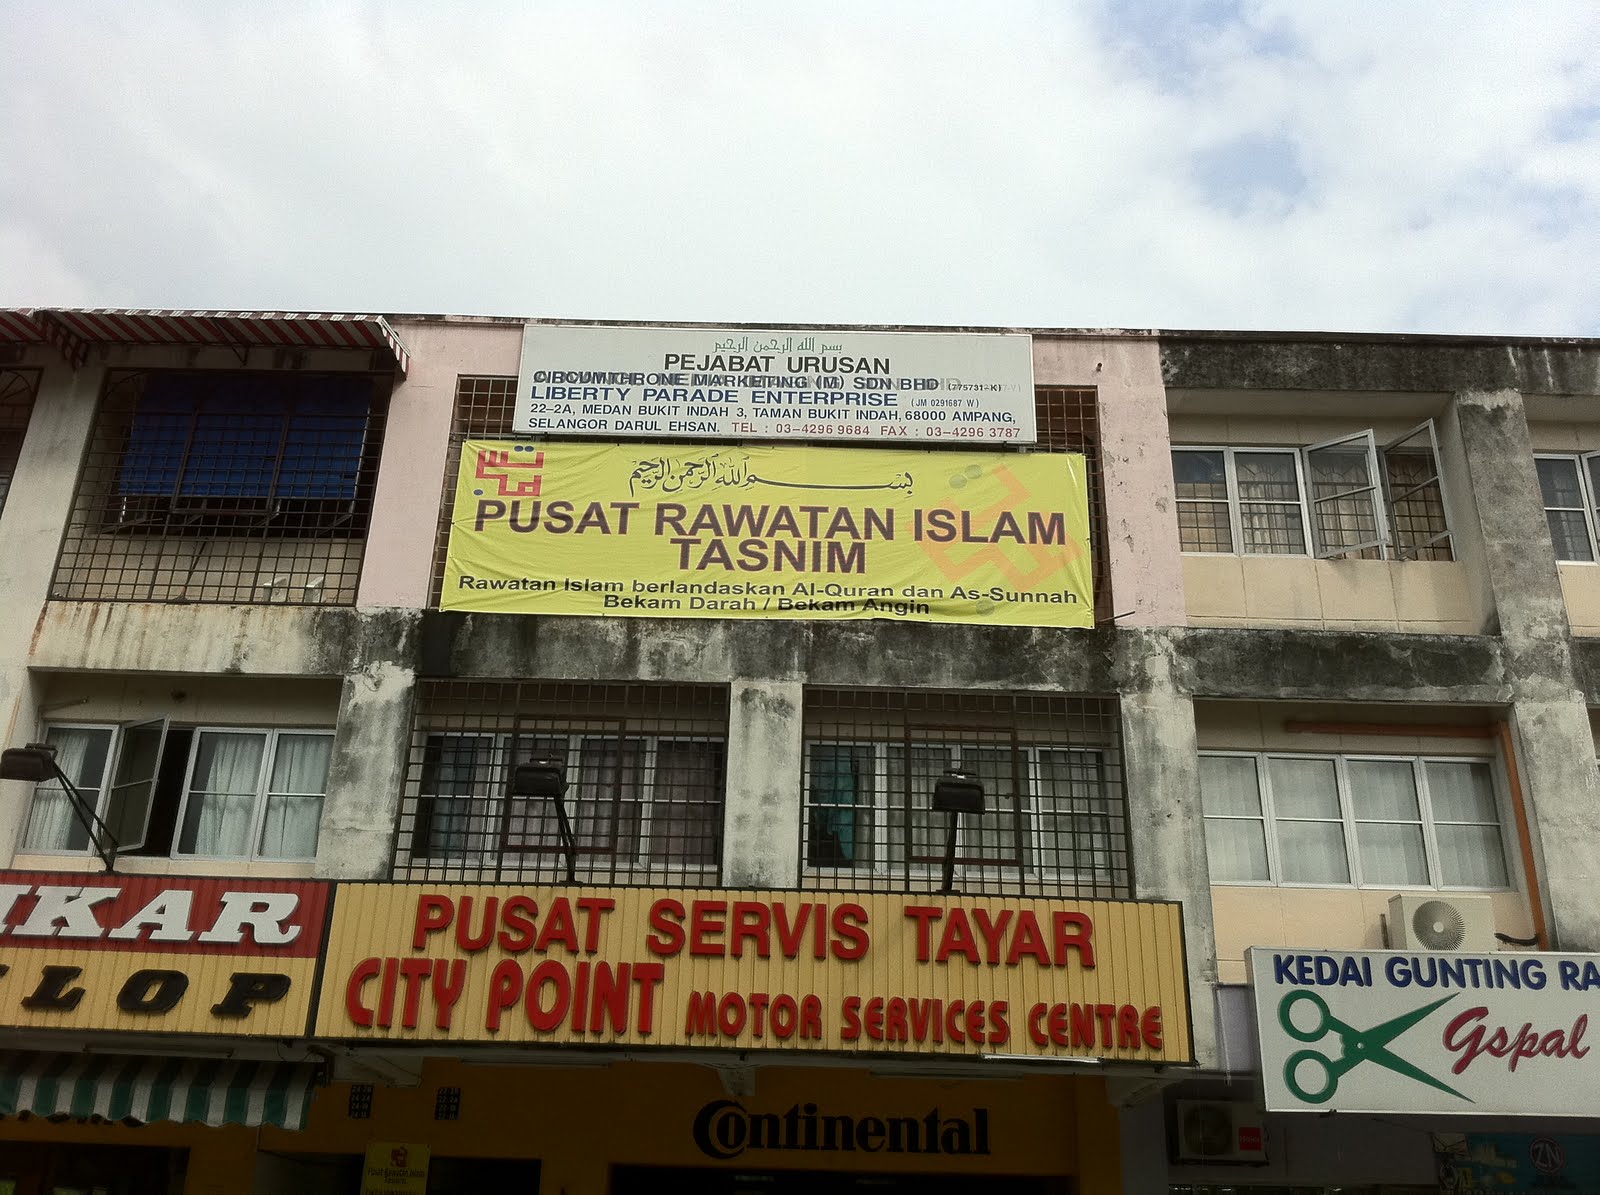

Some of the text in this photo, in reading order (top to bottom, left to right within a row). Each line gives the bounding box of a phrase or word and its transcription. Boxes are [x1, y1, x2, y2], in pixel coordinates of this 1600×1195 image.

[712, 336, 843, 354] بسم الله الرحمن الرحيم
[664, 354, 891, 374] PEJABAT URUSAN
[531, 386, 631, 401] LIBERTY
[643, 388, 739, 403] PARADE
[751, 390, 898, 406] ENTERPRISE
[693, 373, 808, 388] MARKETING
[853, 377, 892, 391] SDN
[901, 378, 939, 391] BHD
[529, 418, 607, 430] SELANGOR
[615, 420, 661, 431] DARUL
[669, 421, 720, 433] EHSAN.
[732, 422, 757, 433] TEL
[837, 425, 869, 435] 9684
[880, 425, 908, 436] FAX
[989, 427, 1021, 438] 3787
[582, 405, 632, 416] MEDAN
[638, 405, 680, 416] BUKIT
[686, 406, 729, 417] INDAH
[736, 407, 748, 419] 3,
[753, 408, 801, 419] TAMAN
[808, 409, 850, 420] BUKIT
[856, 410, 901, 422] INDAH,
[905, 410, 946, 421] 68000
[952, 412, 1016, 424] AMPANG,
[474, 499, 1066, 545] PUSAT RAWATAN ISLAM
[670, 538, 866, 574] TASNIM
[458, 575, 1078, 604] Rawatan Islam berlandaskan Al-Quran dan As-Sunnah
[603, 594, 681, 609] Bekam
[689, 596, 756, 611] Darah
[778, 598, 855, 612] Bekam
[862, 599, 930, 615] Angin
[412, 894, 1097, 969] PUSAT SERVIS TAYAR
[1273, 954, 1372, 987] KEDAI
[1385, 956, 1548, 990] GUNTING
[0, 964, 291, 1019] LOP
[346, 956, 1162, 1049] CITY POINT MOTOR SERVICES CENTRE
[1443, 1006, 1590, 1075] Gspal
[693, 1099, 991, 1159] Continental
